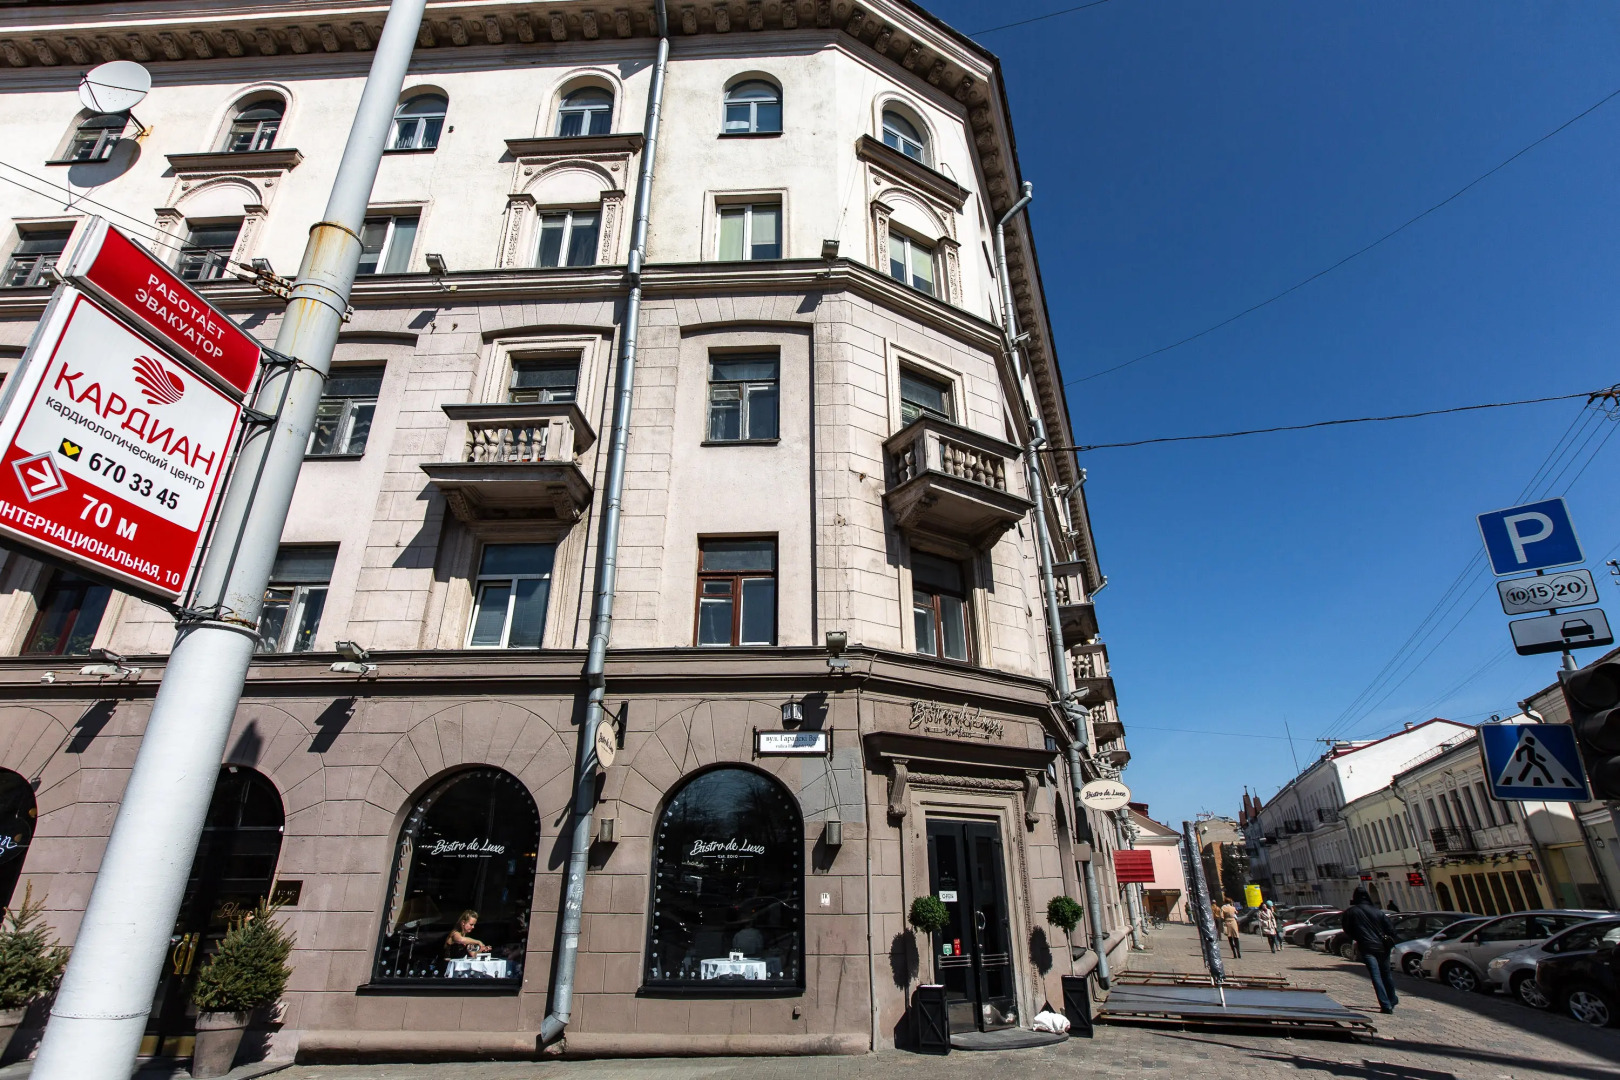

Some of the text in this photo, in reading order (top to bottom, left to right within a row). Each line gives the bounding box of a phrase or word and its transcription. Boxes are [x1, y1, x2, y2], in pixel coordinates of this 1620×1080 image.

[134, 288, 224, 358] ЭВАКУАТОР
[147, 273, 226, 340] РАБОТАЕТ
[45, 396, 206, 490] кардиологический центр
[53, 361, 216, 476] КАРДИАН
[88, 452, 181, 511] 670 33 45
[79, 493, 113, 528] 70
[1503, 511, 1554, 564] P
[165, 569, 181, 586] 10
[1510, 582, 1581, 602] 10 15 20
[430, 837, 505, 856] Bistro de Luxe
[689, 837, 765, 856] Bistro de Luxe
